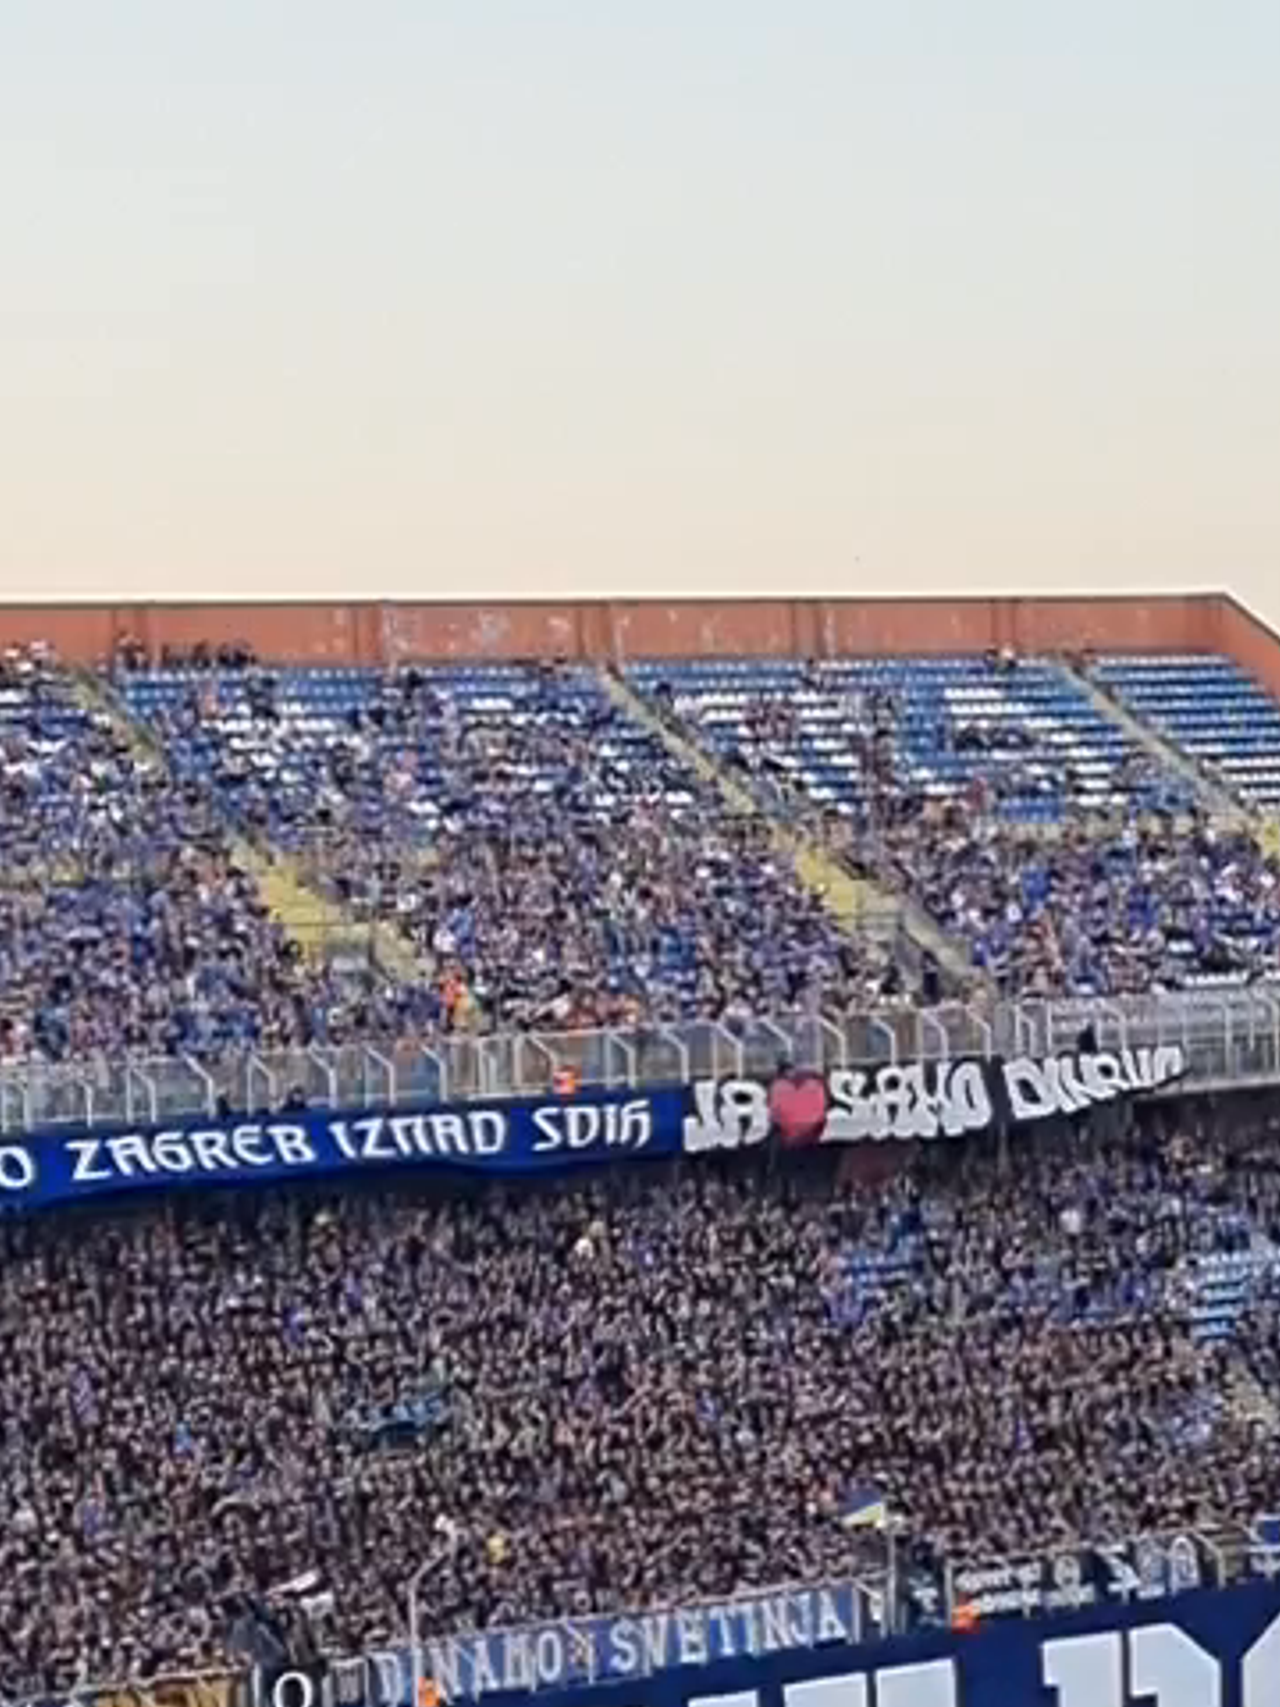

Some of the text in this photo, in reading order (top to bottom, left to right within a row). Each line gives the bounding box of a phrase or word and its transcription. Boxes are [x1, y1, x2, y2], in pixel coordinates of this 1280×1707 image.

[65, 1124, 317, 1182] ZAGREB
[328, 1109, 507, 1159] IZNAD
[682, 1079, 770, 1154] JA
[820, 1061, 993, 1142] SAMO
